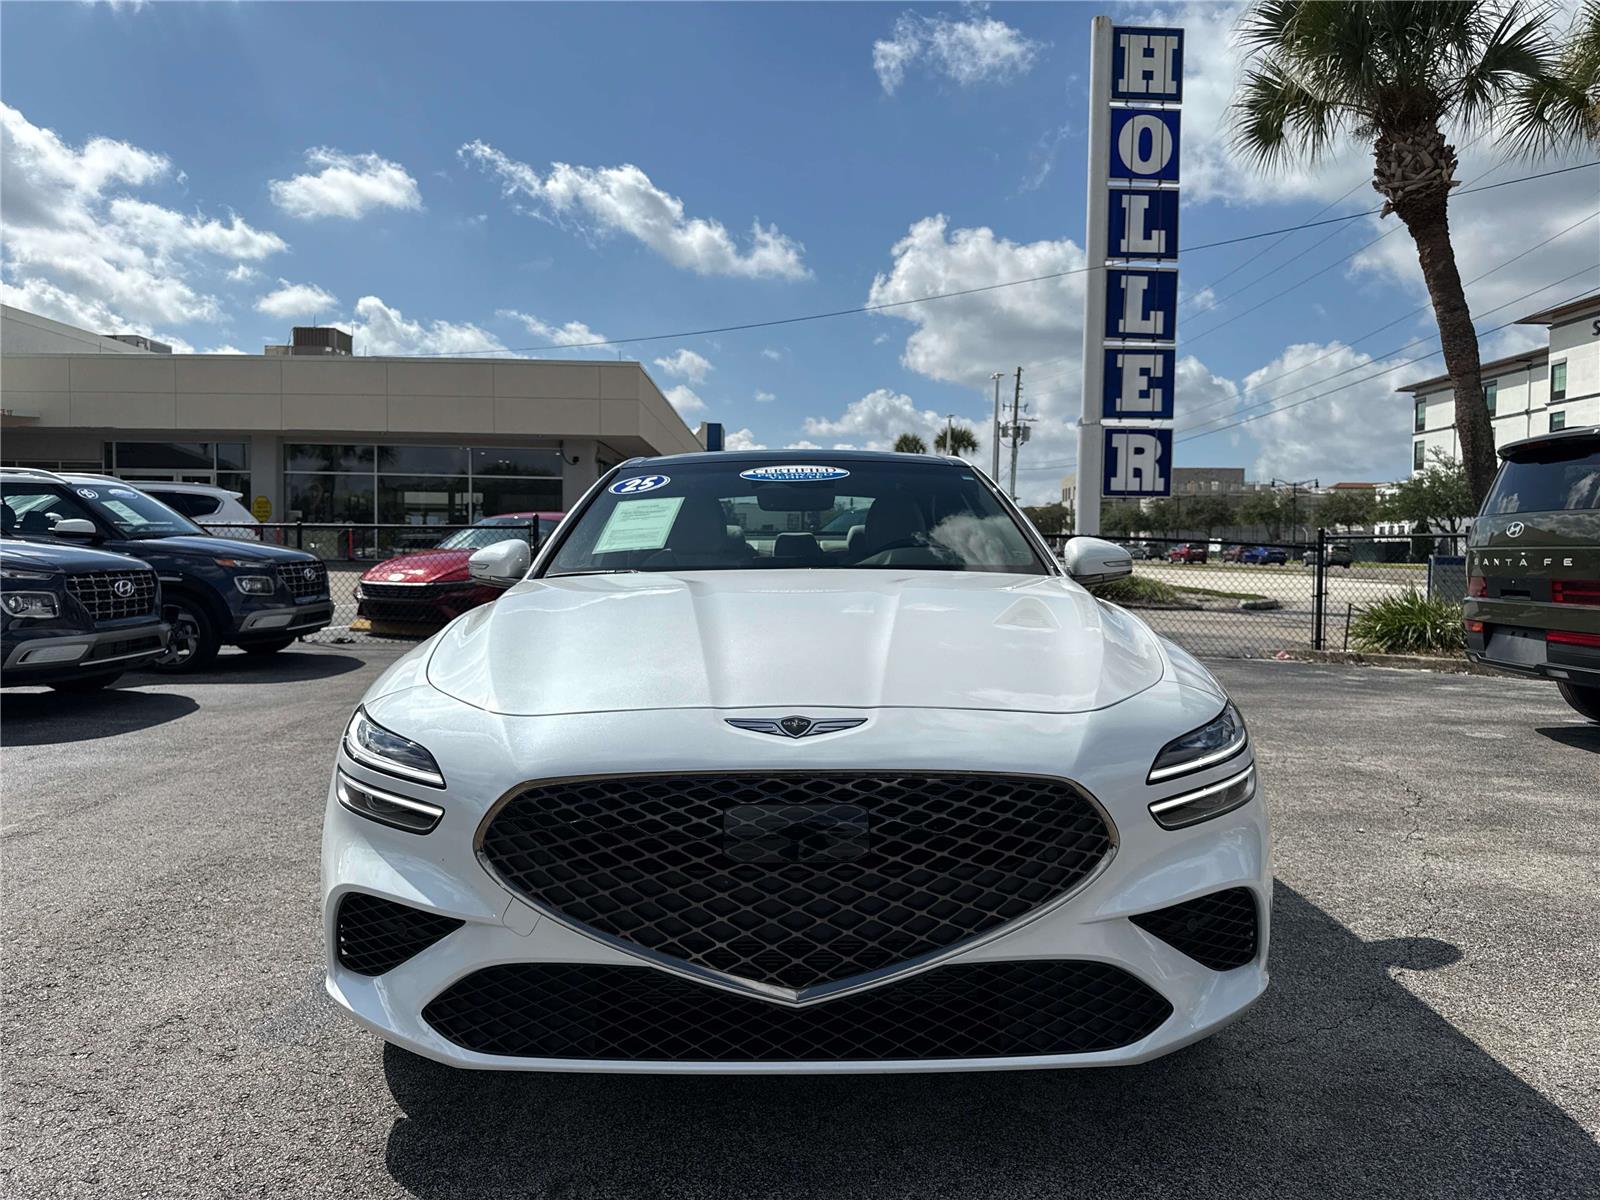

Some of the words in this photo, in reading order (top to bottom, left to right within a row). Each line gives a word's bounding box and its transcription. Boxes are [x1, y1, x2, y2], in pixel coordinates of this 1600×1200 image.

[1110, 34, 1178, 492] HOLLER
[620, 476, 658, 493] 25
[1474, 558, 1528, 567] SANTA
[1543, 558, 1573, 567] FE
